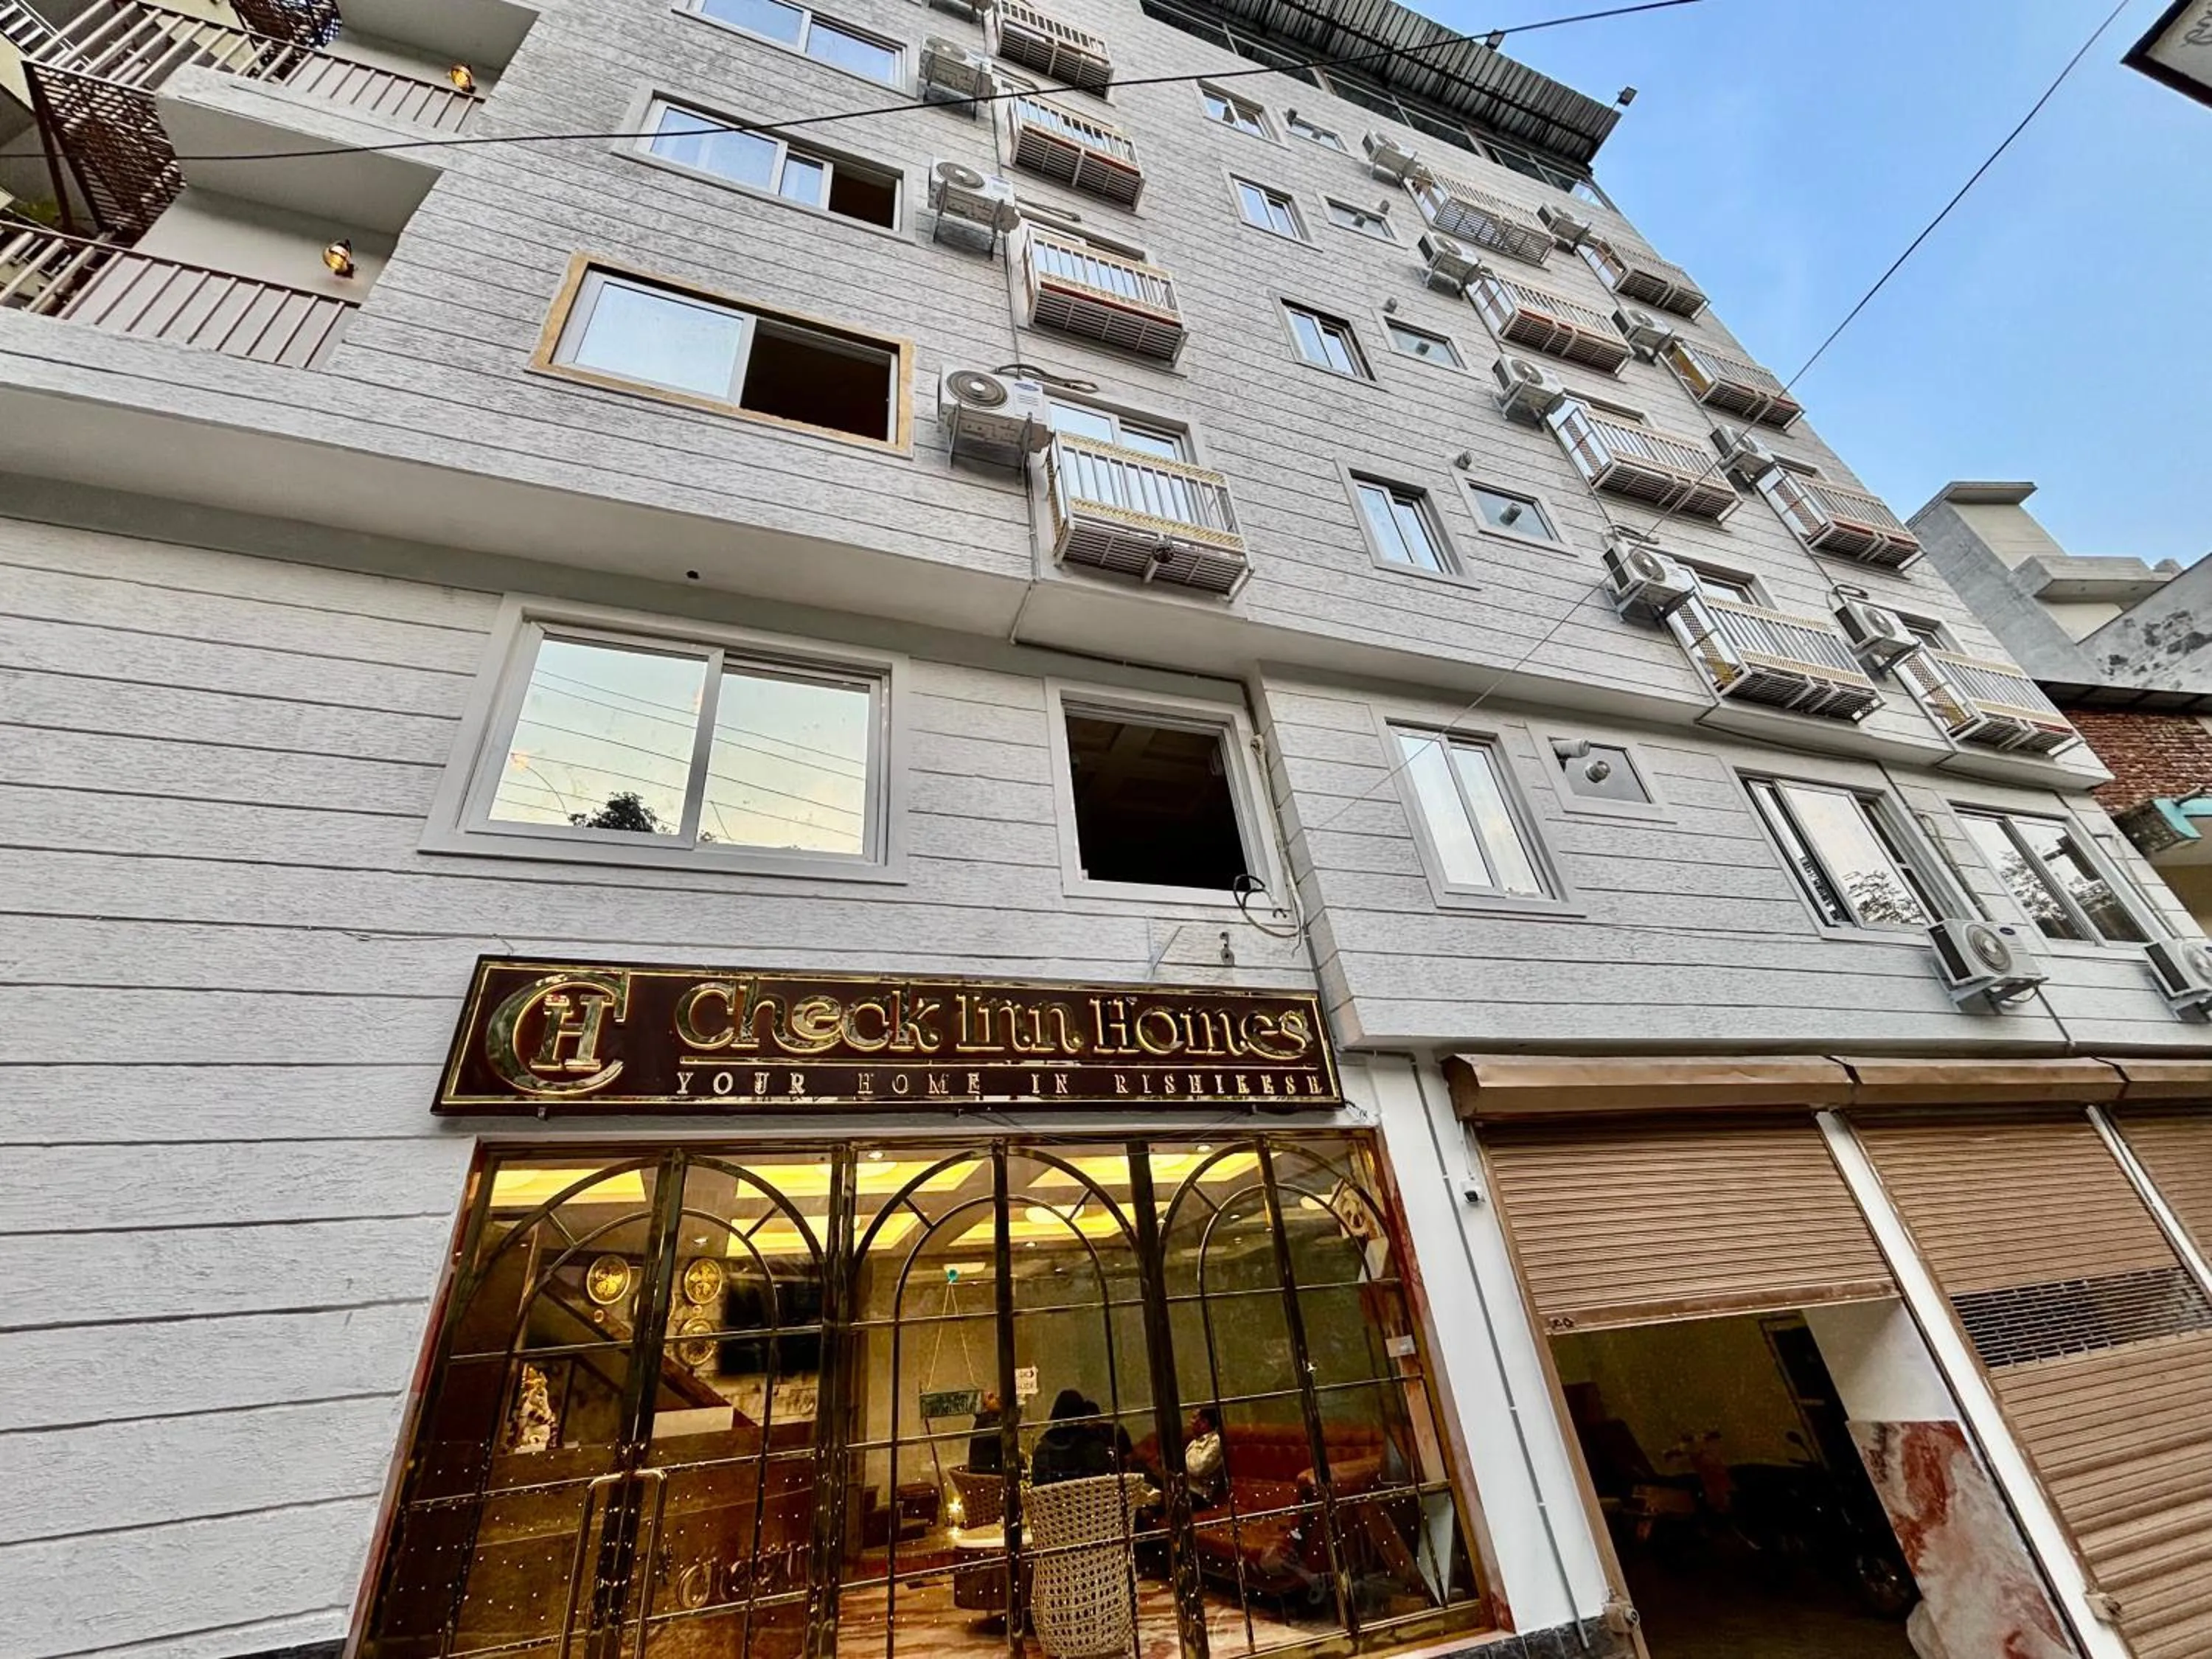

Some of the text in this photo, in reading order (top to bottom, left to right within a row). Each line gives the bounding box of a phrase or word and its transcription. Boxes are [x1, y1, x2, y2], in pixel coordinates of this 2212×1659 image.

[675, 977, 1314, 1060] Check Inn Homes
[676, 1071, 1324, 1096] YOUR HOME IN RISHIKESH
